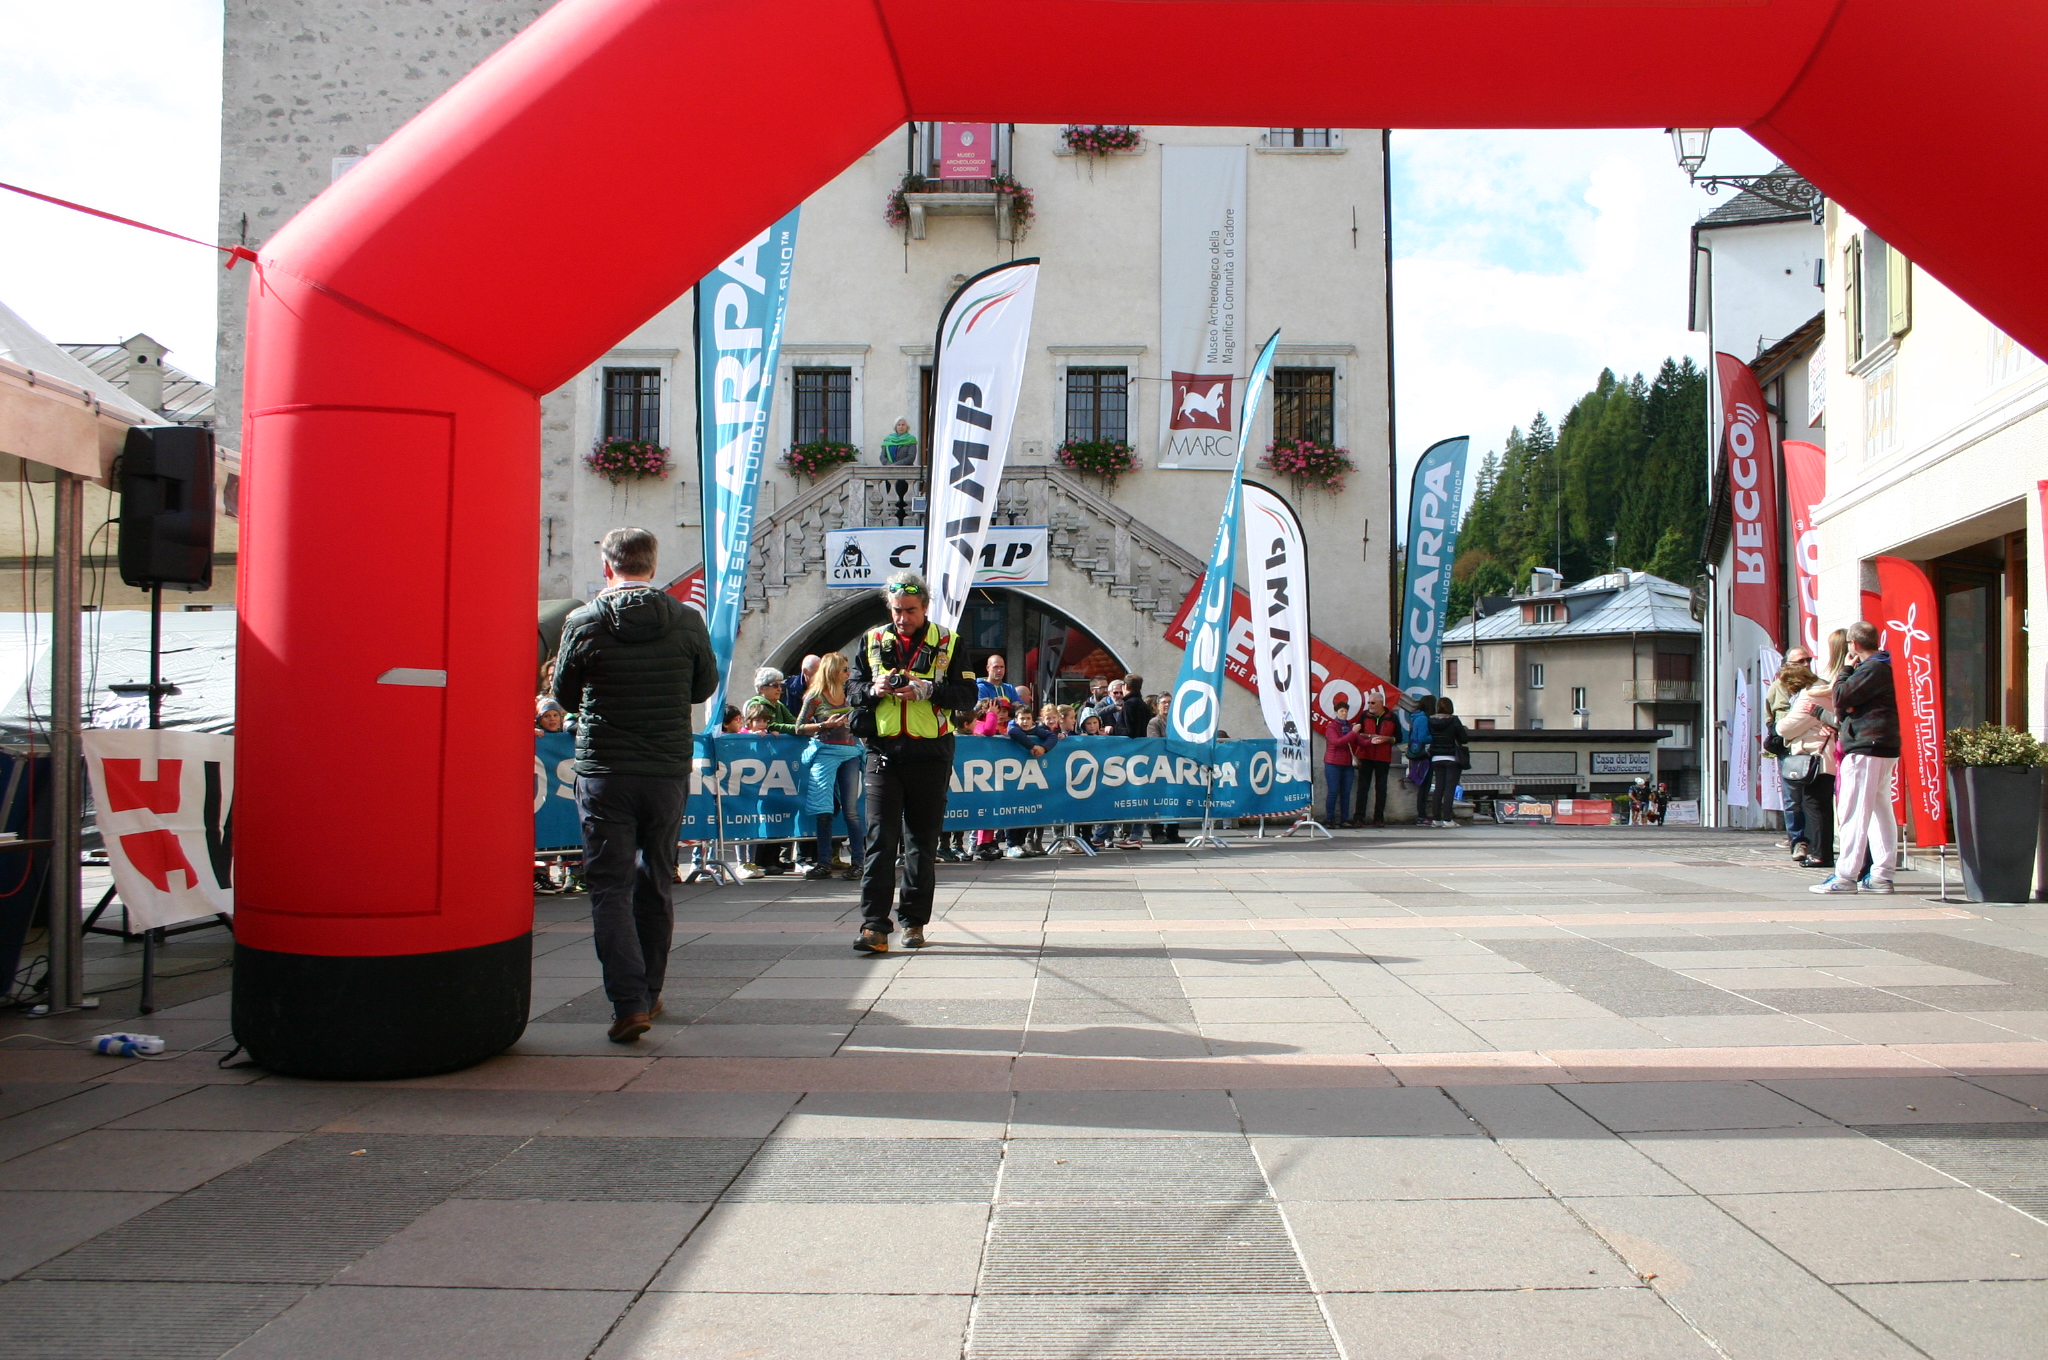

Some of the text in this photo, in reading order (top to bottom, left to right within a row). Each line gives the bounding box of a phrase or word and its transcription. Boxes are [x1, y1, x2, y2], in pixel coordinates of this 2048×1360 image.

[1207, 230, 1221, 364] Museo Archeologico della
[1222, 208, 1236, 364] Magnifica Comunità di Cadore
[1167, 435, 1233, 457] MARC
[725, 504, 753, 606] NESSUN
[744, 410, 767, 486] LUOGO
[942, 382, 993, 618] CAMP
[833, 568, 872, 579] CAMP
[1408, 460, 1453, 681] SCARPA
[1434, 611, 1447, 664] NESSUN
[1442, 563, 1452, 603] LUOGO
[949, 759, 1049, 793] ARPA
[1101, 755, 1238, 788] SCARPA
[1595, 753, 1649, 764] Casa del Dolce
[1114, 798, 1149, 808] NESSUN
